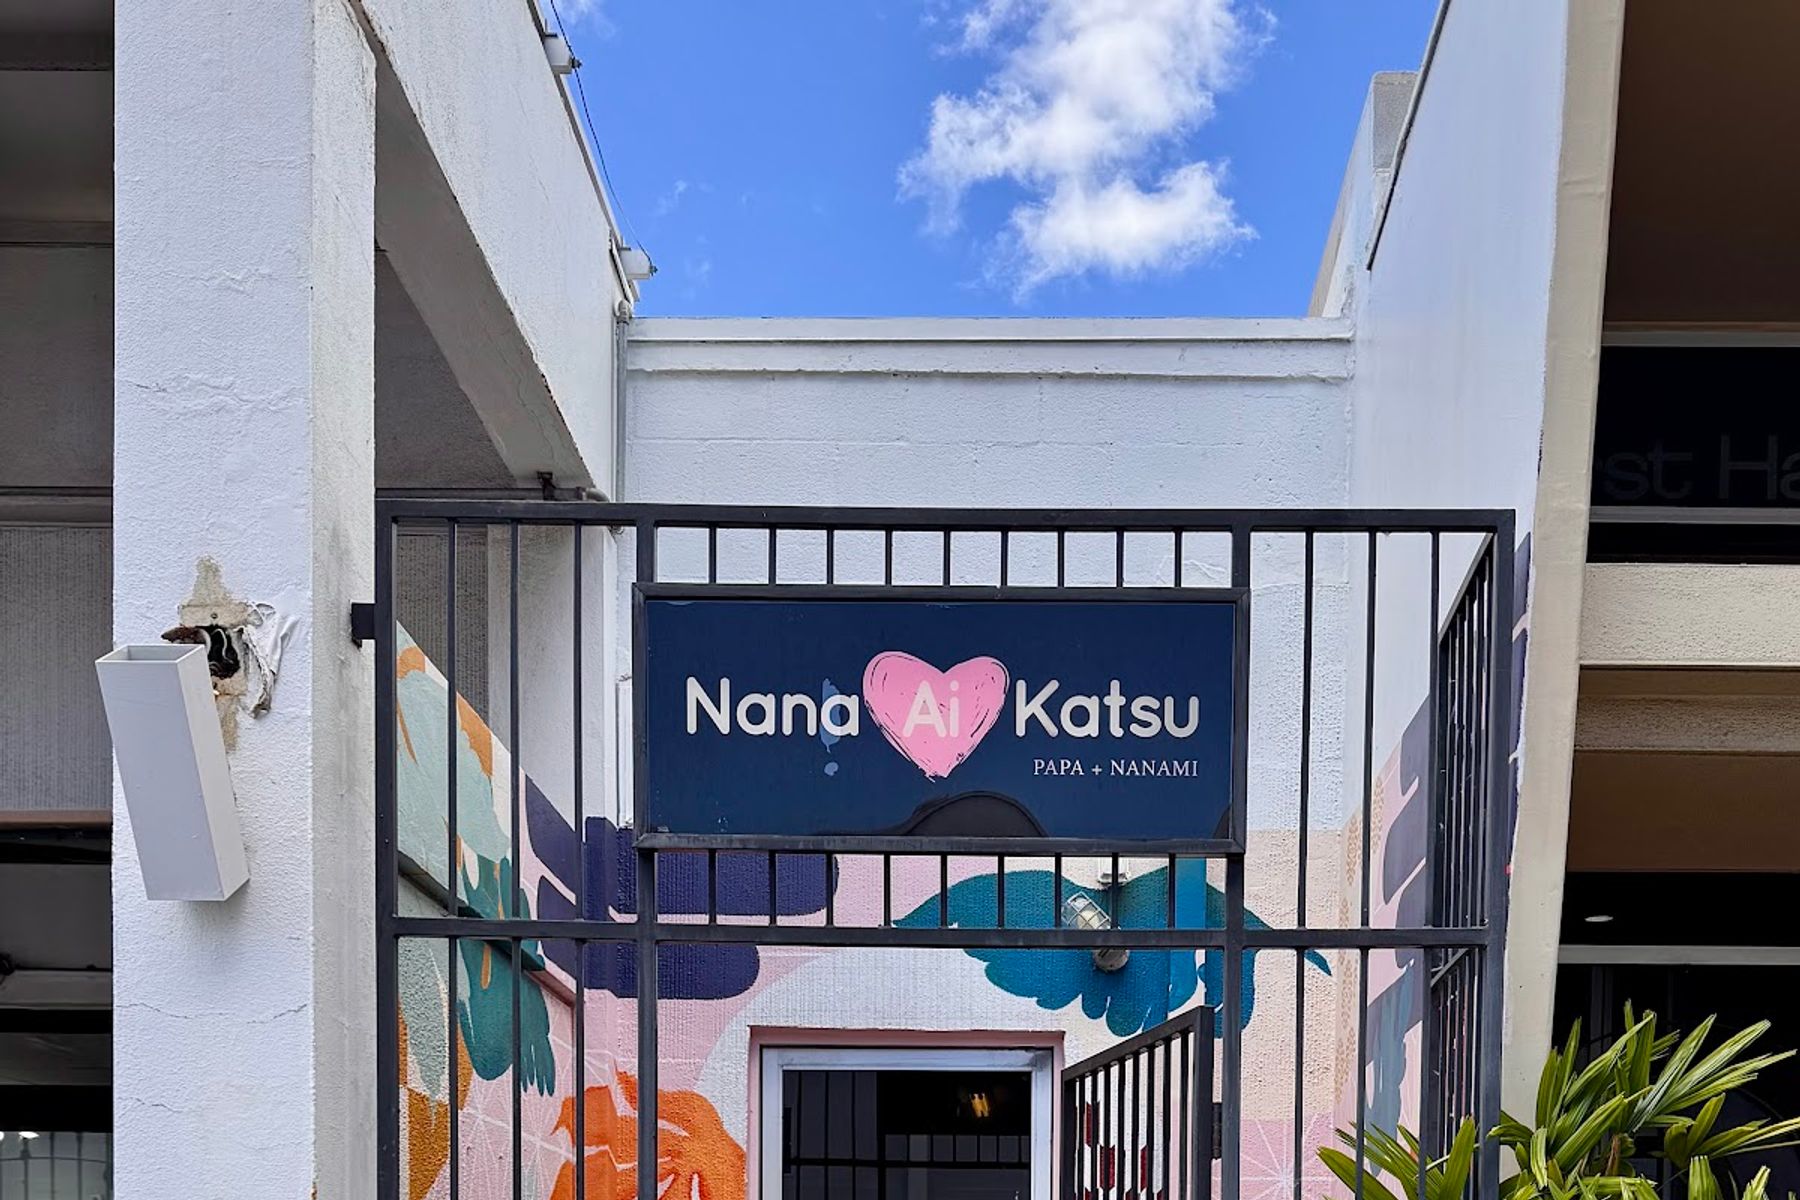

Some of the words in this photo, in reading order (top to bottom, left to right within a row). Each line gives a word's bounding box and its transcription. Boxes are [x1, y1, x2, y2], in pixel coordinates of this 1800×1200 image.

[1595, 438, 1693, 500] st
[686, 676, 860, 737] Nana
[903, 679, 960, 738] Ai
[1014, 679, 1200, 738] Katsu
[1033, 759, 1085, 776] PAPA
[1091, 764, 1104, 776] +
[1110, 760, 1199, 777] NANAMI
